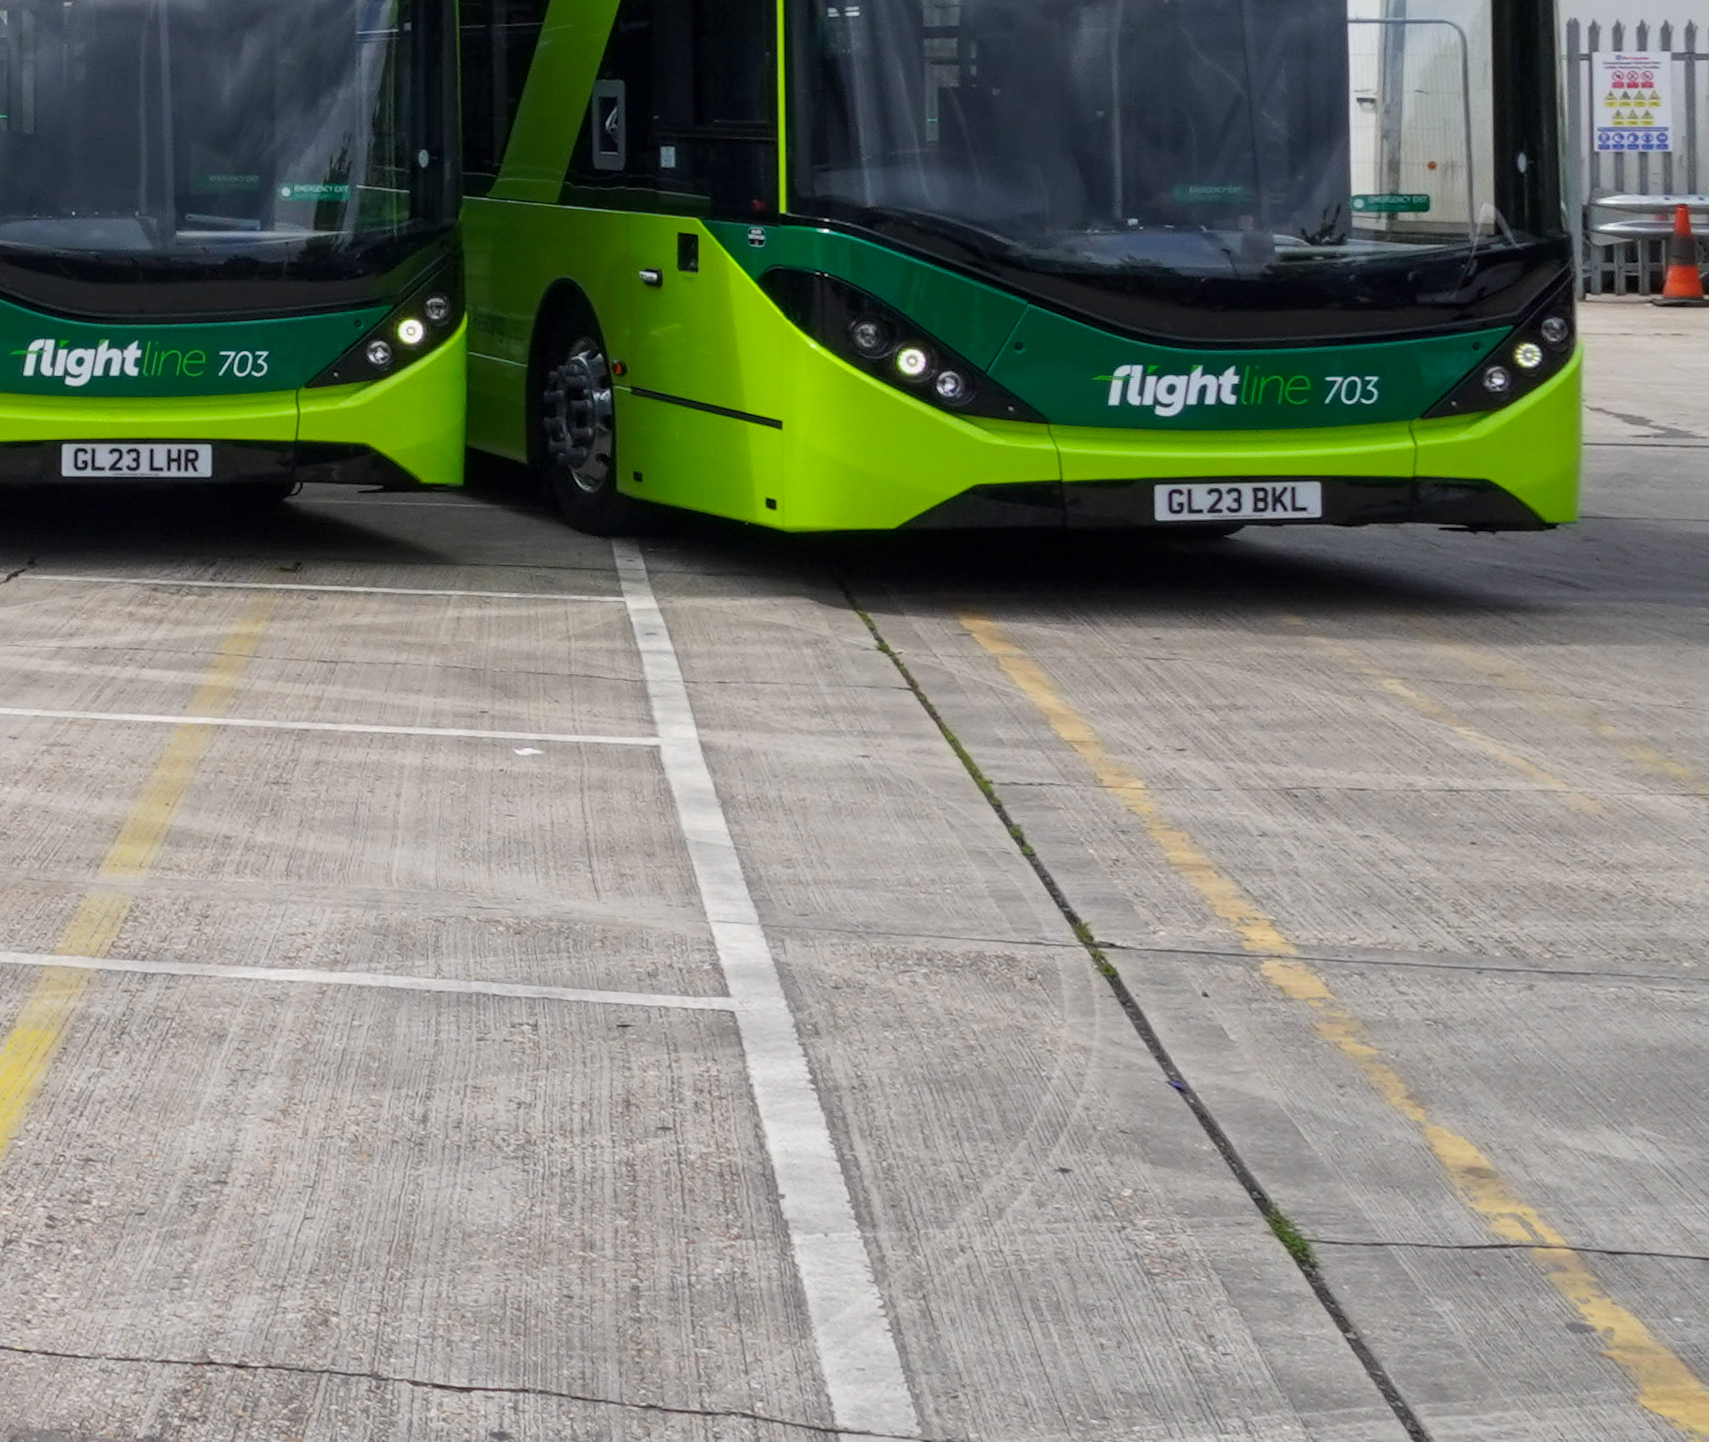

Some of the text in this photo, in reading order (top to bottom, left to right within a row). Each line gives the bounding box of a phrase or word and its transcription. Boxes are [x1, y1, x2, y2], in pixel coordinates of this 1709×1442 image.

[217, 350, 270, 378] 703
[1323, 375, 1380, 405] 703
[73, 448, 199, 472] GL23 LHR
[1167, 486, 1308, 515] GL23 BKL
